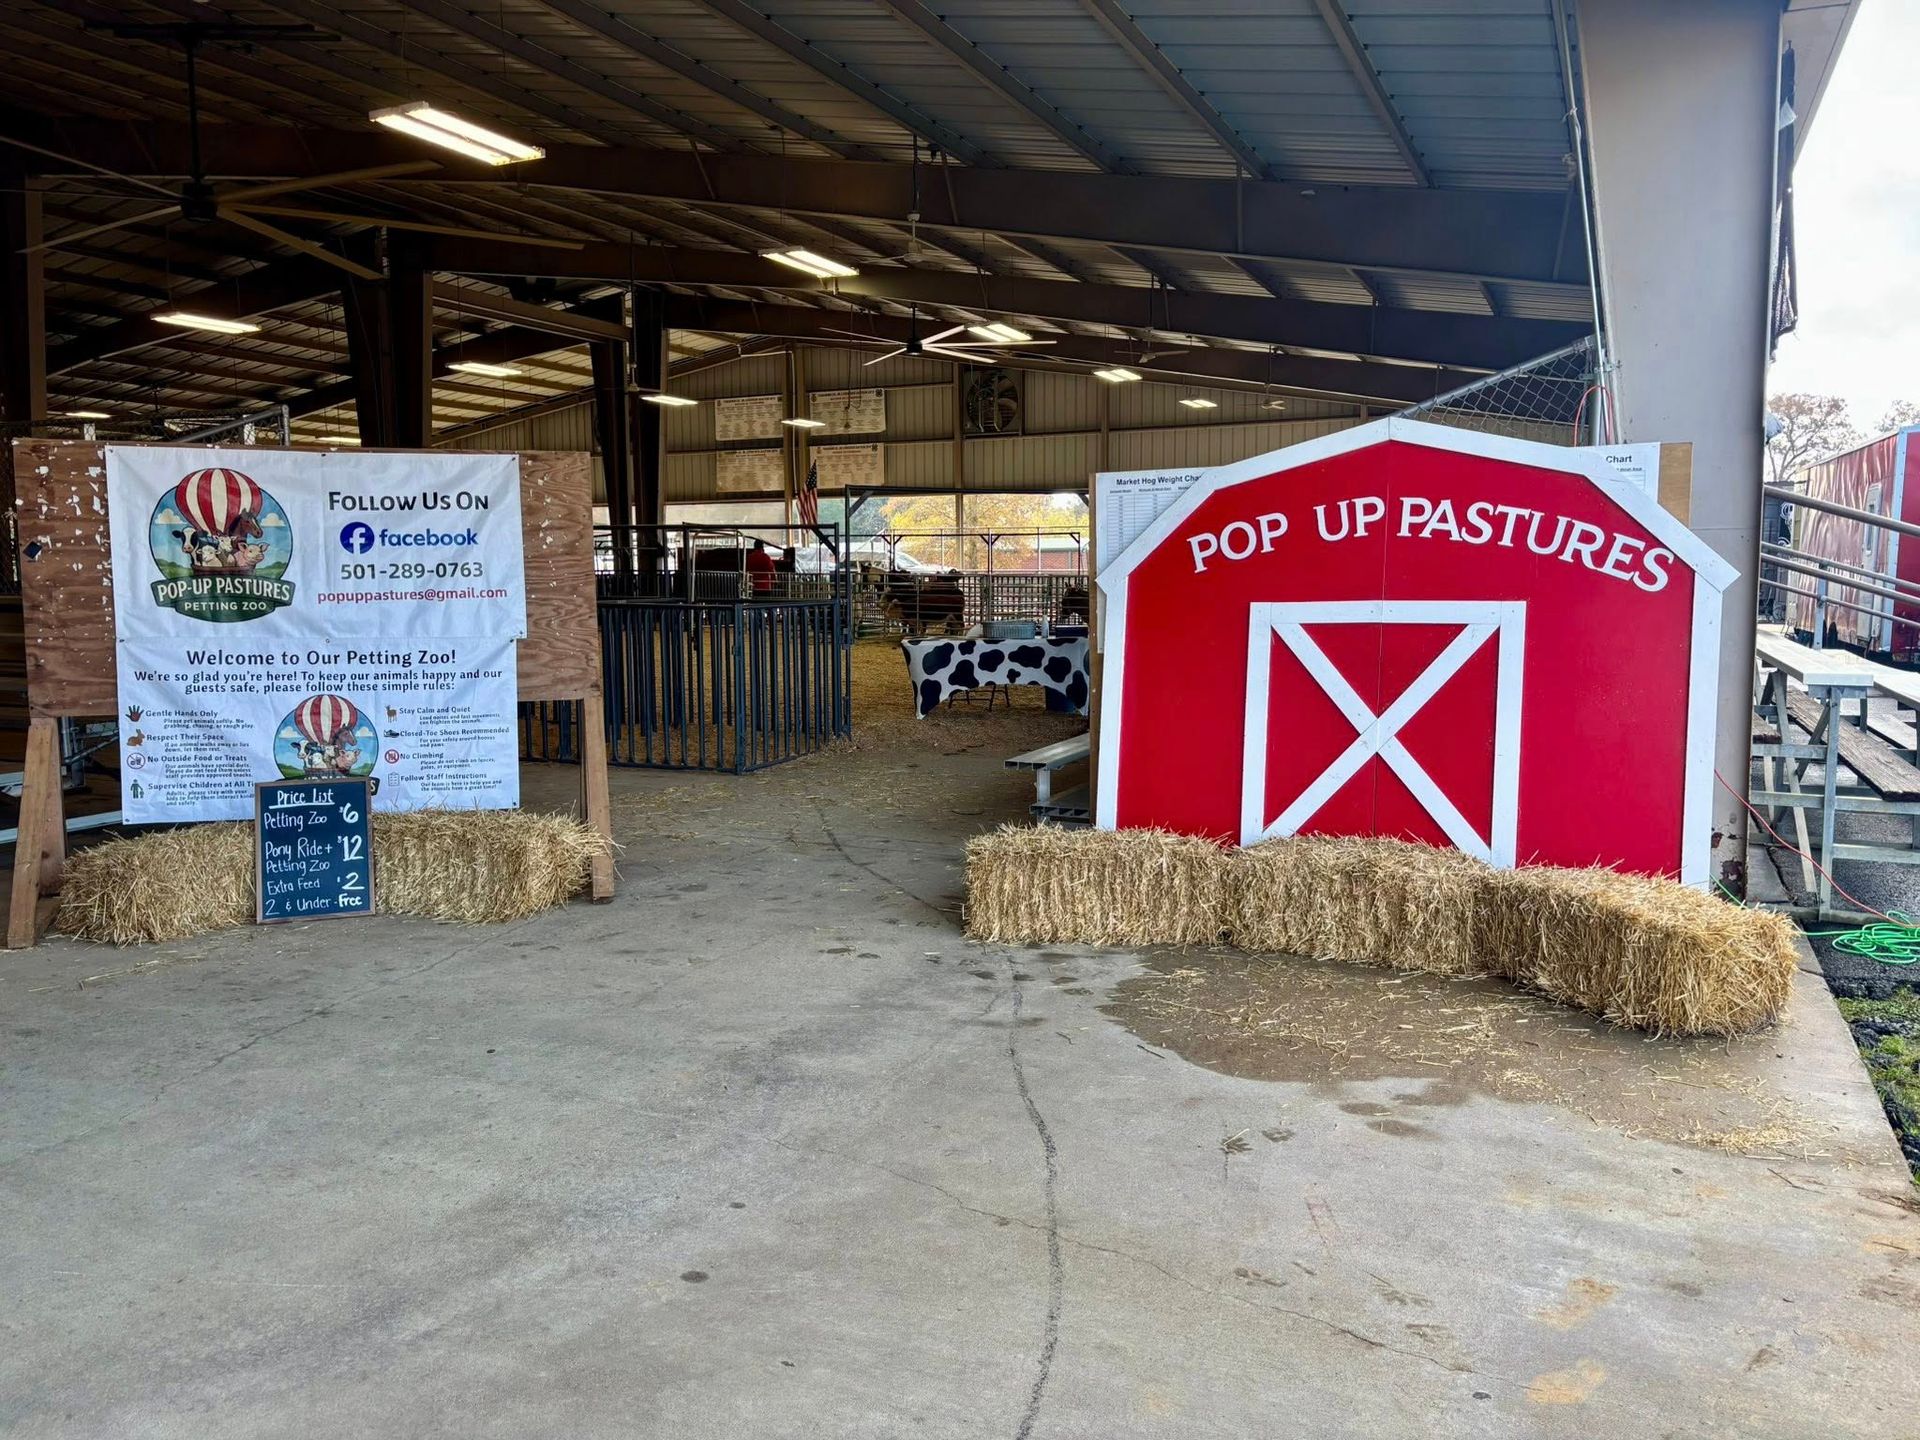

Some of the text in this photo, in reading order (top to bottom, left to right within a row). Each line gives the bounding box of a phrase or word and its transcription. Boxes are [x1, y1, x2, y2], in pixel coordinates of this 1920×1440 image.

[1116, 474, 1201, 486] Market Hog Weight Cha
[328, 491, 489, 511] FOLLOW US ON
[379, 528, 479, 547] facebook
[1187, 511, 1288, 574] POP
[1313, 496, 1386, 542] UP
[1397, 496, 1675, 592] PASTURES
[340, 561, 483, 580] 501-289-0763
[157, 577, 290, 602] POP-UP PASTURES
[317, 586, 508, 605] popuppastures@gmail.com
[184, 601, 267, 611] PETTING ZOO
[186, 649, 457, 668] Welcome to Our Petting Zoo!
[134, 669, 503, 684] We're so glad you're here! To keep our animals happy and our
[185, 679, 455, 695] guests safe, please follow these simple rules:
[145, 709, 218, 718] Gentle Hands Only
[399, 707, 415, 715] Stay
[416, 706, 435, 714] Calm
[146, 733, 224, 742] Respect Their Space
[400, 726, 510, 737] Closed-Toe Shoes Recommended
[147, 755, 159, 763] No
[193, 754, 213, 762] Food
[399, 751, 444, 760] No Climbing
[147, 782, 187, 791] Supervise
[189, 781, 222, 789] Children
[234, 780, 245, 788] All
[246, 780, 254, 788] Ti
[400, 774, 425, 782] Follow
[426, 772, 444, 780] Staff
[277, 787, 334, 806] Price List
[263, 810, 304, 833] Petting
[307, 811, 328, 825] Zoo
[265, 840, 292, 861] Pony
[266, 859, 330, 876] Petting Zoo
[266, 879, 295, 896] Extra
[297, 878, 320, 890] Feed
[265, 898, 280, 916] 2
[296, 896, 331, 912] Under
[338, 893, 363, 908] Free
